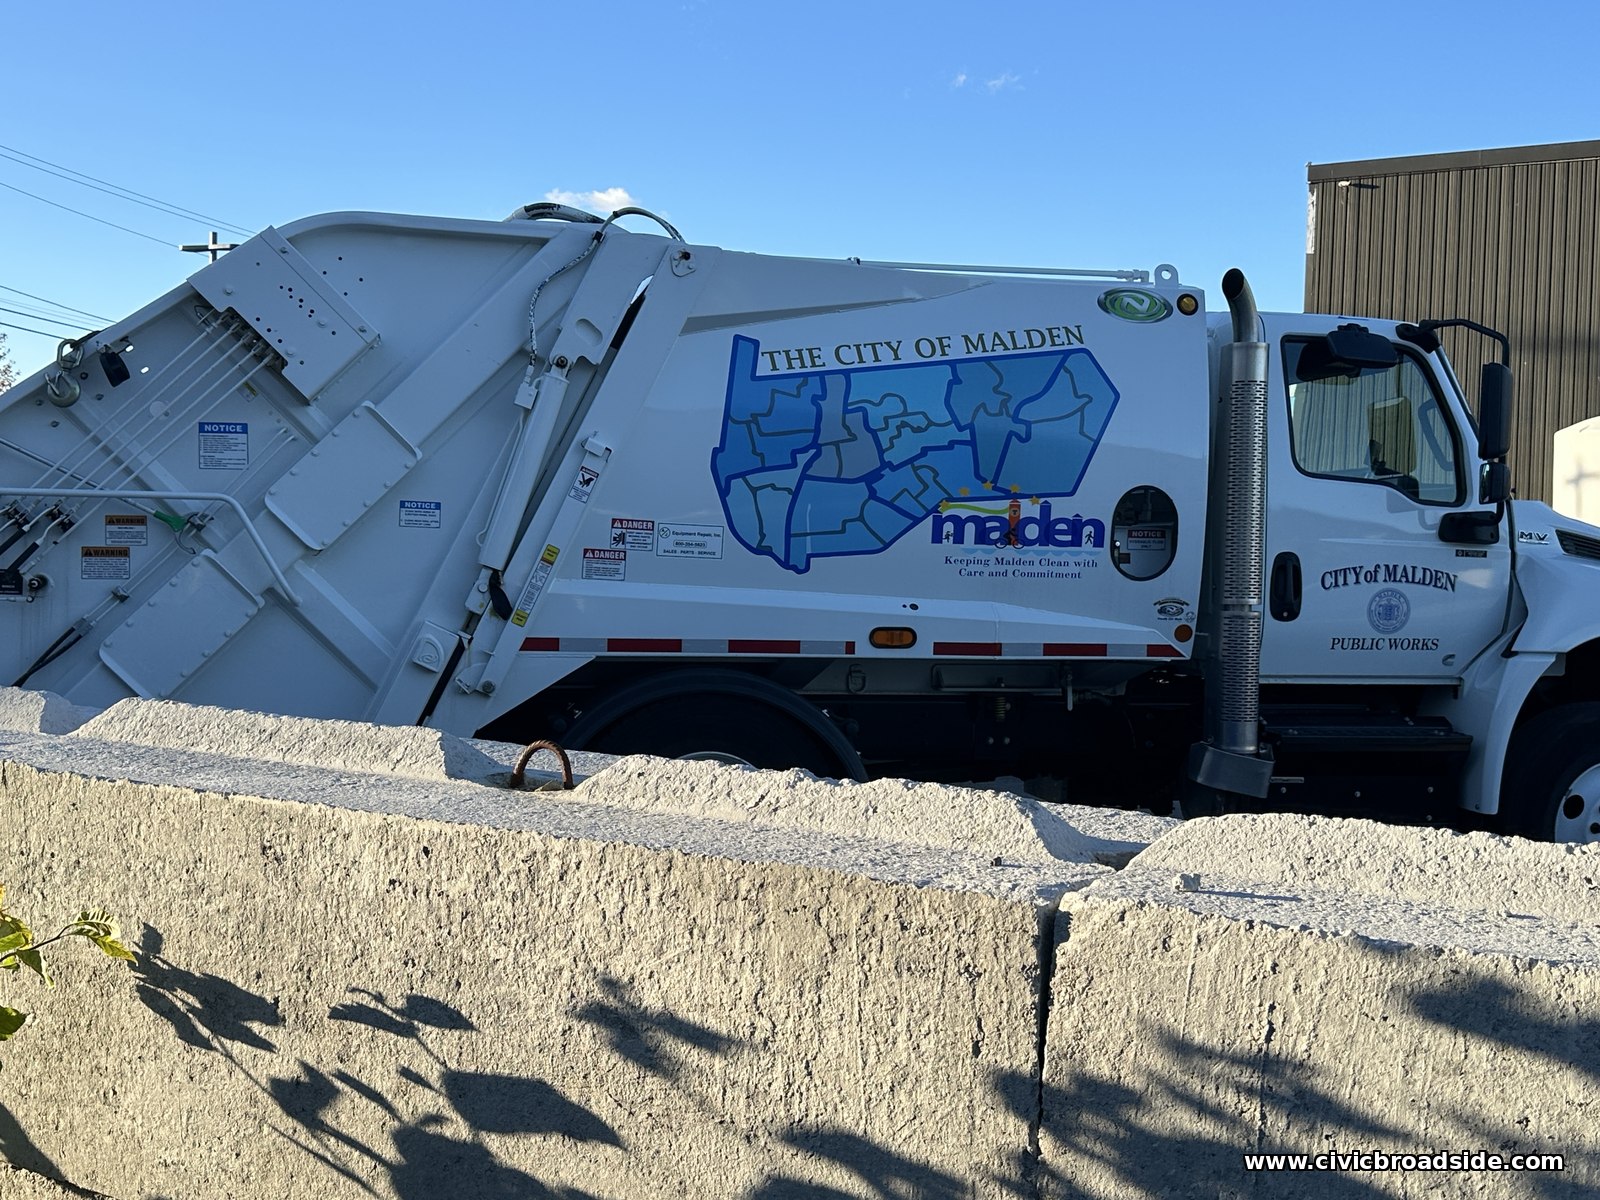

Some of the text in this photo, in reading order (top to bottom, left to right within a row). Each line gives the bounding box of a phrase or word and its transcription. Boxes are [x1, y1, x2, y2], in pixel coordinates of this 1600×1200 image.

[761, 324, 1085, 372] THE CITY OF MALDEN
[204, 424, 243, 432] NOTICE
[404, 501, 436, 509] NOTICE
[622, 520, 653, 530] DANGER
[1131, 530, 1162, 538] NOTICE
[93, 549, 128, 557] WARNING
[594, 550, 625, 560] DANGER
[944, 556, 1098, 568] Keeping Malden Clean with
[958, 568, 1081, 579] Care and Commitment
[1320, 563, 1458, 593] CITY of MALDEN
[1330, 637, 1440, 651] PUBLIC WORKS
